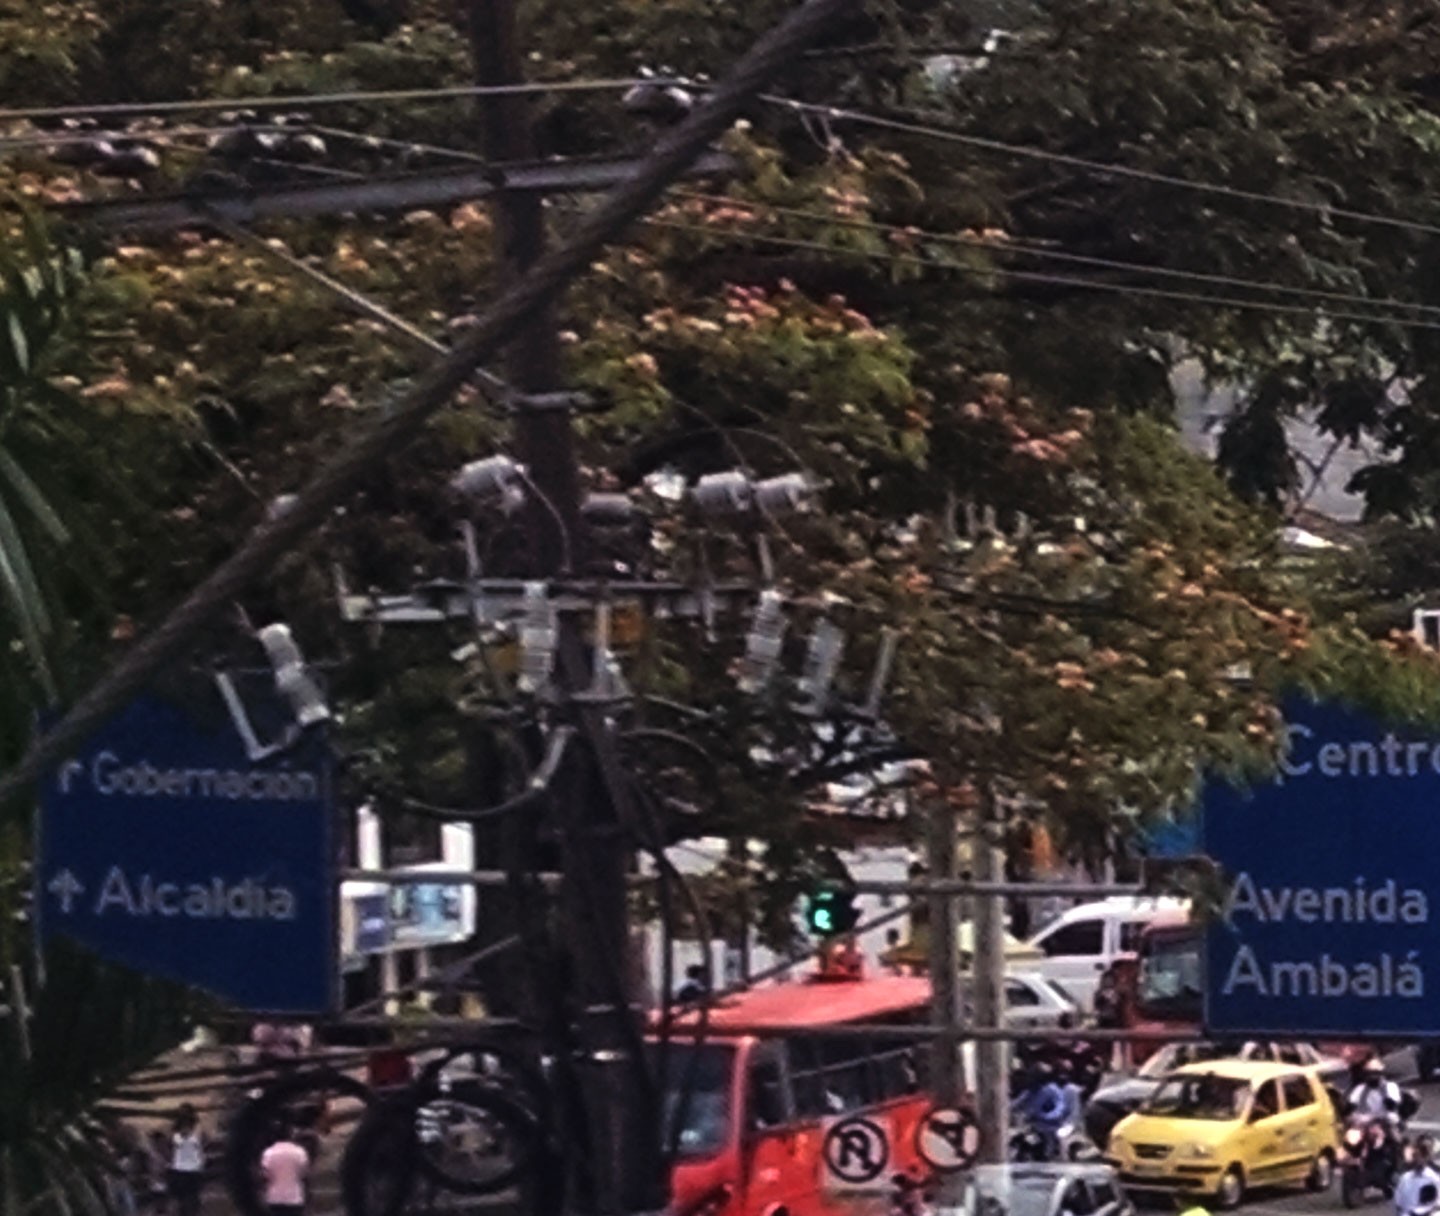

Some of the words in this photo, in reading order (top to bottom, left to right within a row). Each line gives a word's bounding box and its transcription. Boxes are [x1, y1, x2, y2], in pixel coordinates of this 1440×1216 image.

[95, 864, 297, 920] Alcaldía
[1222, 871, 1429, 923] Avenida
[1221, 944, 1424, 997] Ambalá
